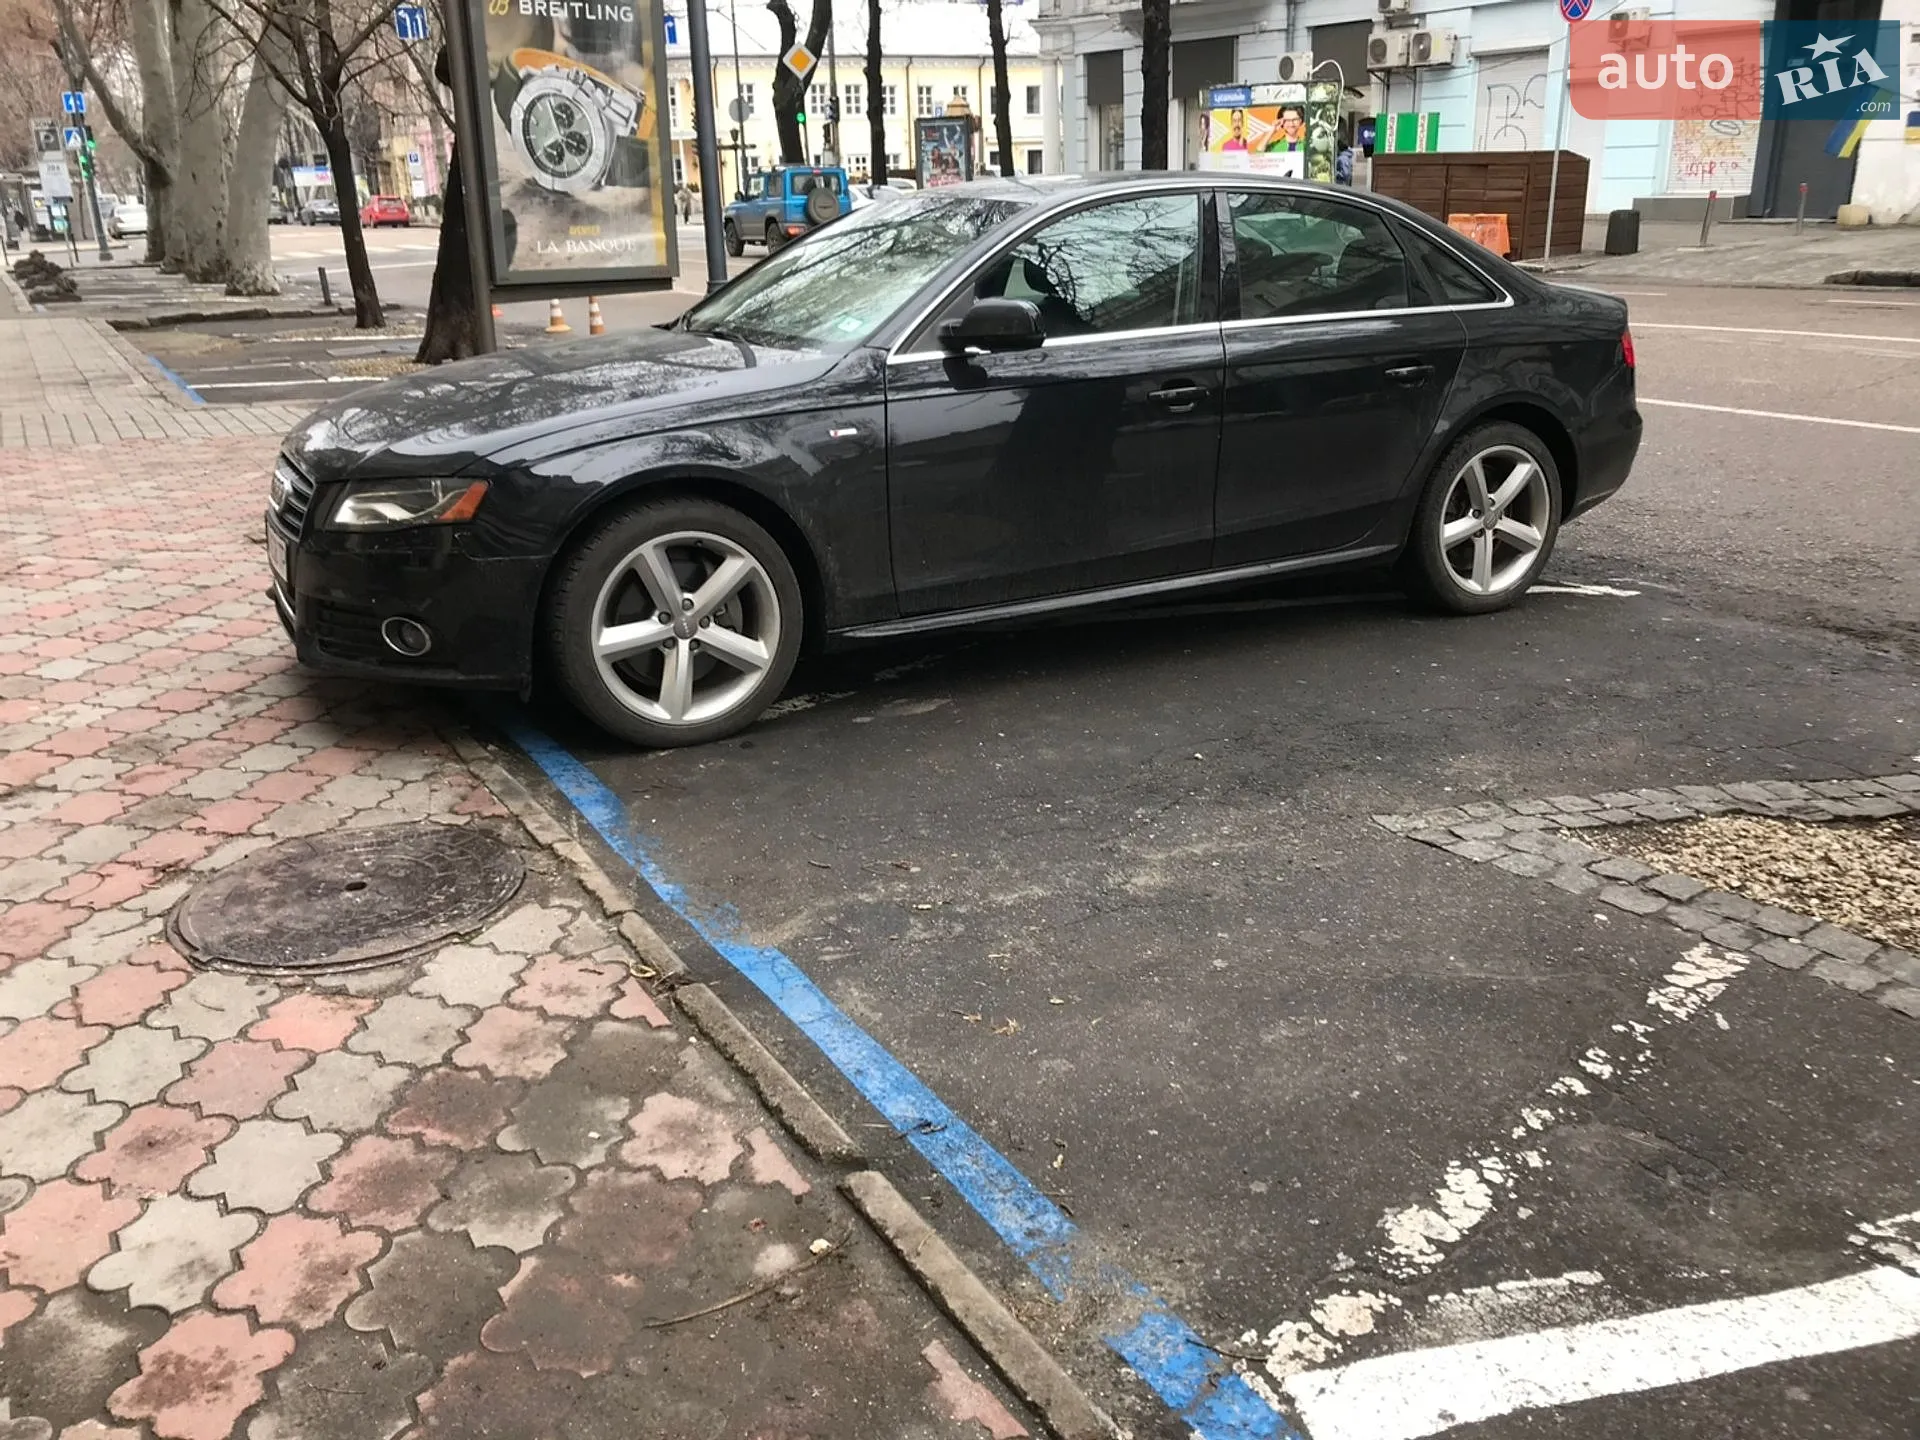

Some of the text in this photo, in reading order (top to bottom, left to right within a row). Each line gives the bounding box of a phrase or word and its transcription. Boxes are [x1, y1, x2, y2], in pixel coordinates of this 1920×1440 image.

[518, 0, 634, 23] BREITLING
[536, 238, 637, 254] LA BANQUE
